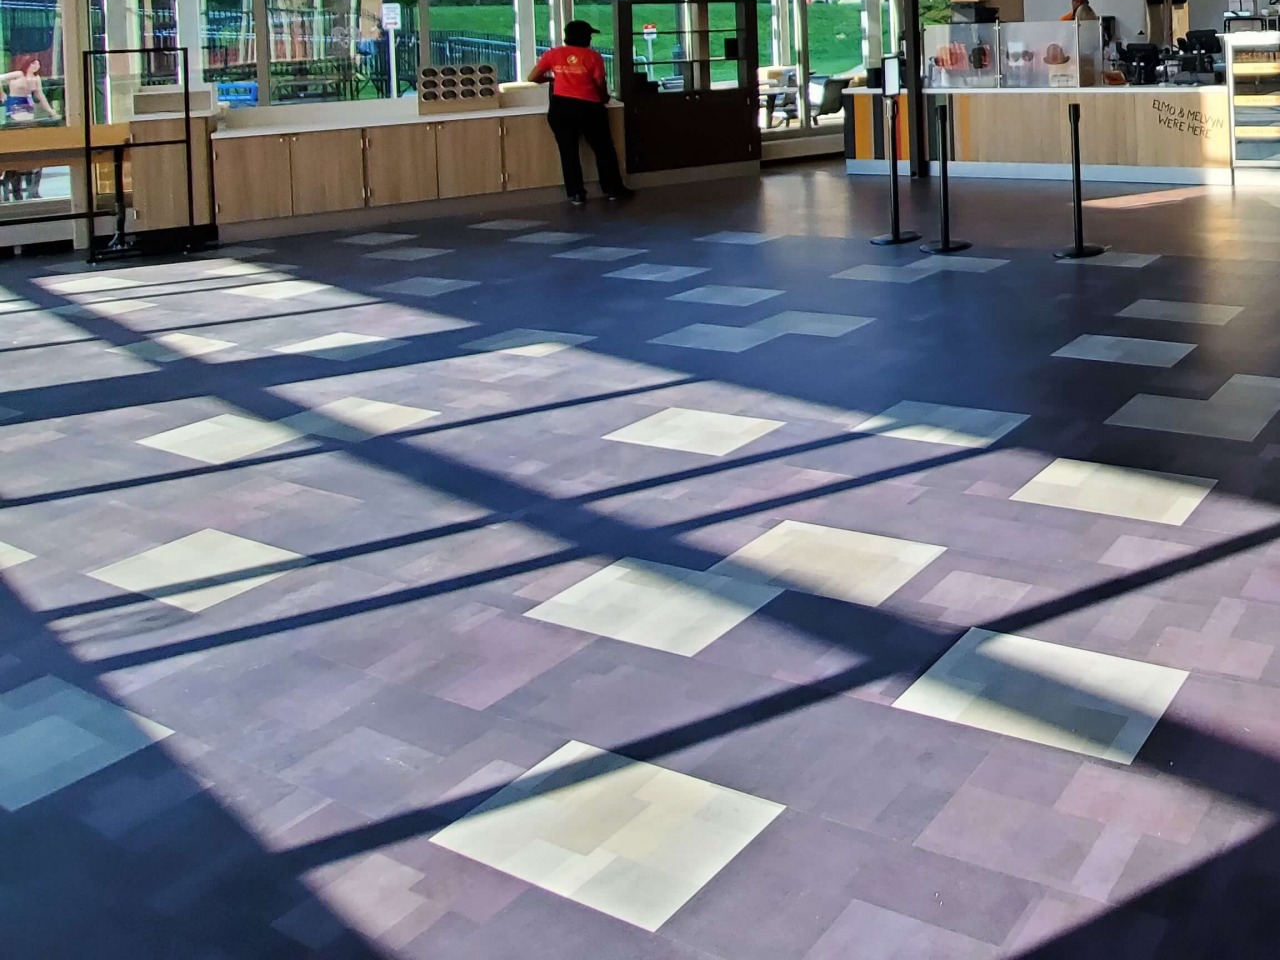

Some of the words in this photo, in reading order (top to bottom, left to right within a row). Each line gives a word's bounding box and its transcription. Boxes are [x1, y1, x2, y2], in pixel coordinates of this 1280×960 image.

[1152, 98, 1176, 116] ELMO
[1177, 107, 1185, 118] &
[1186, 109, 1224, 128] MELVYN
[1158, 113, 1185, 132] WERE
[1187, 124, 1211, 139] HERE
